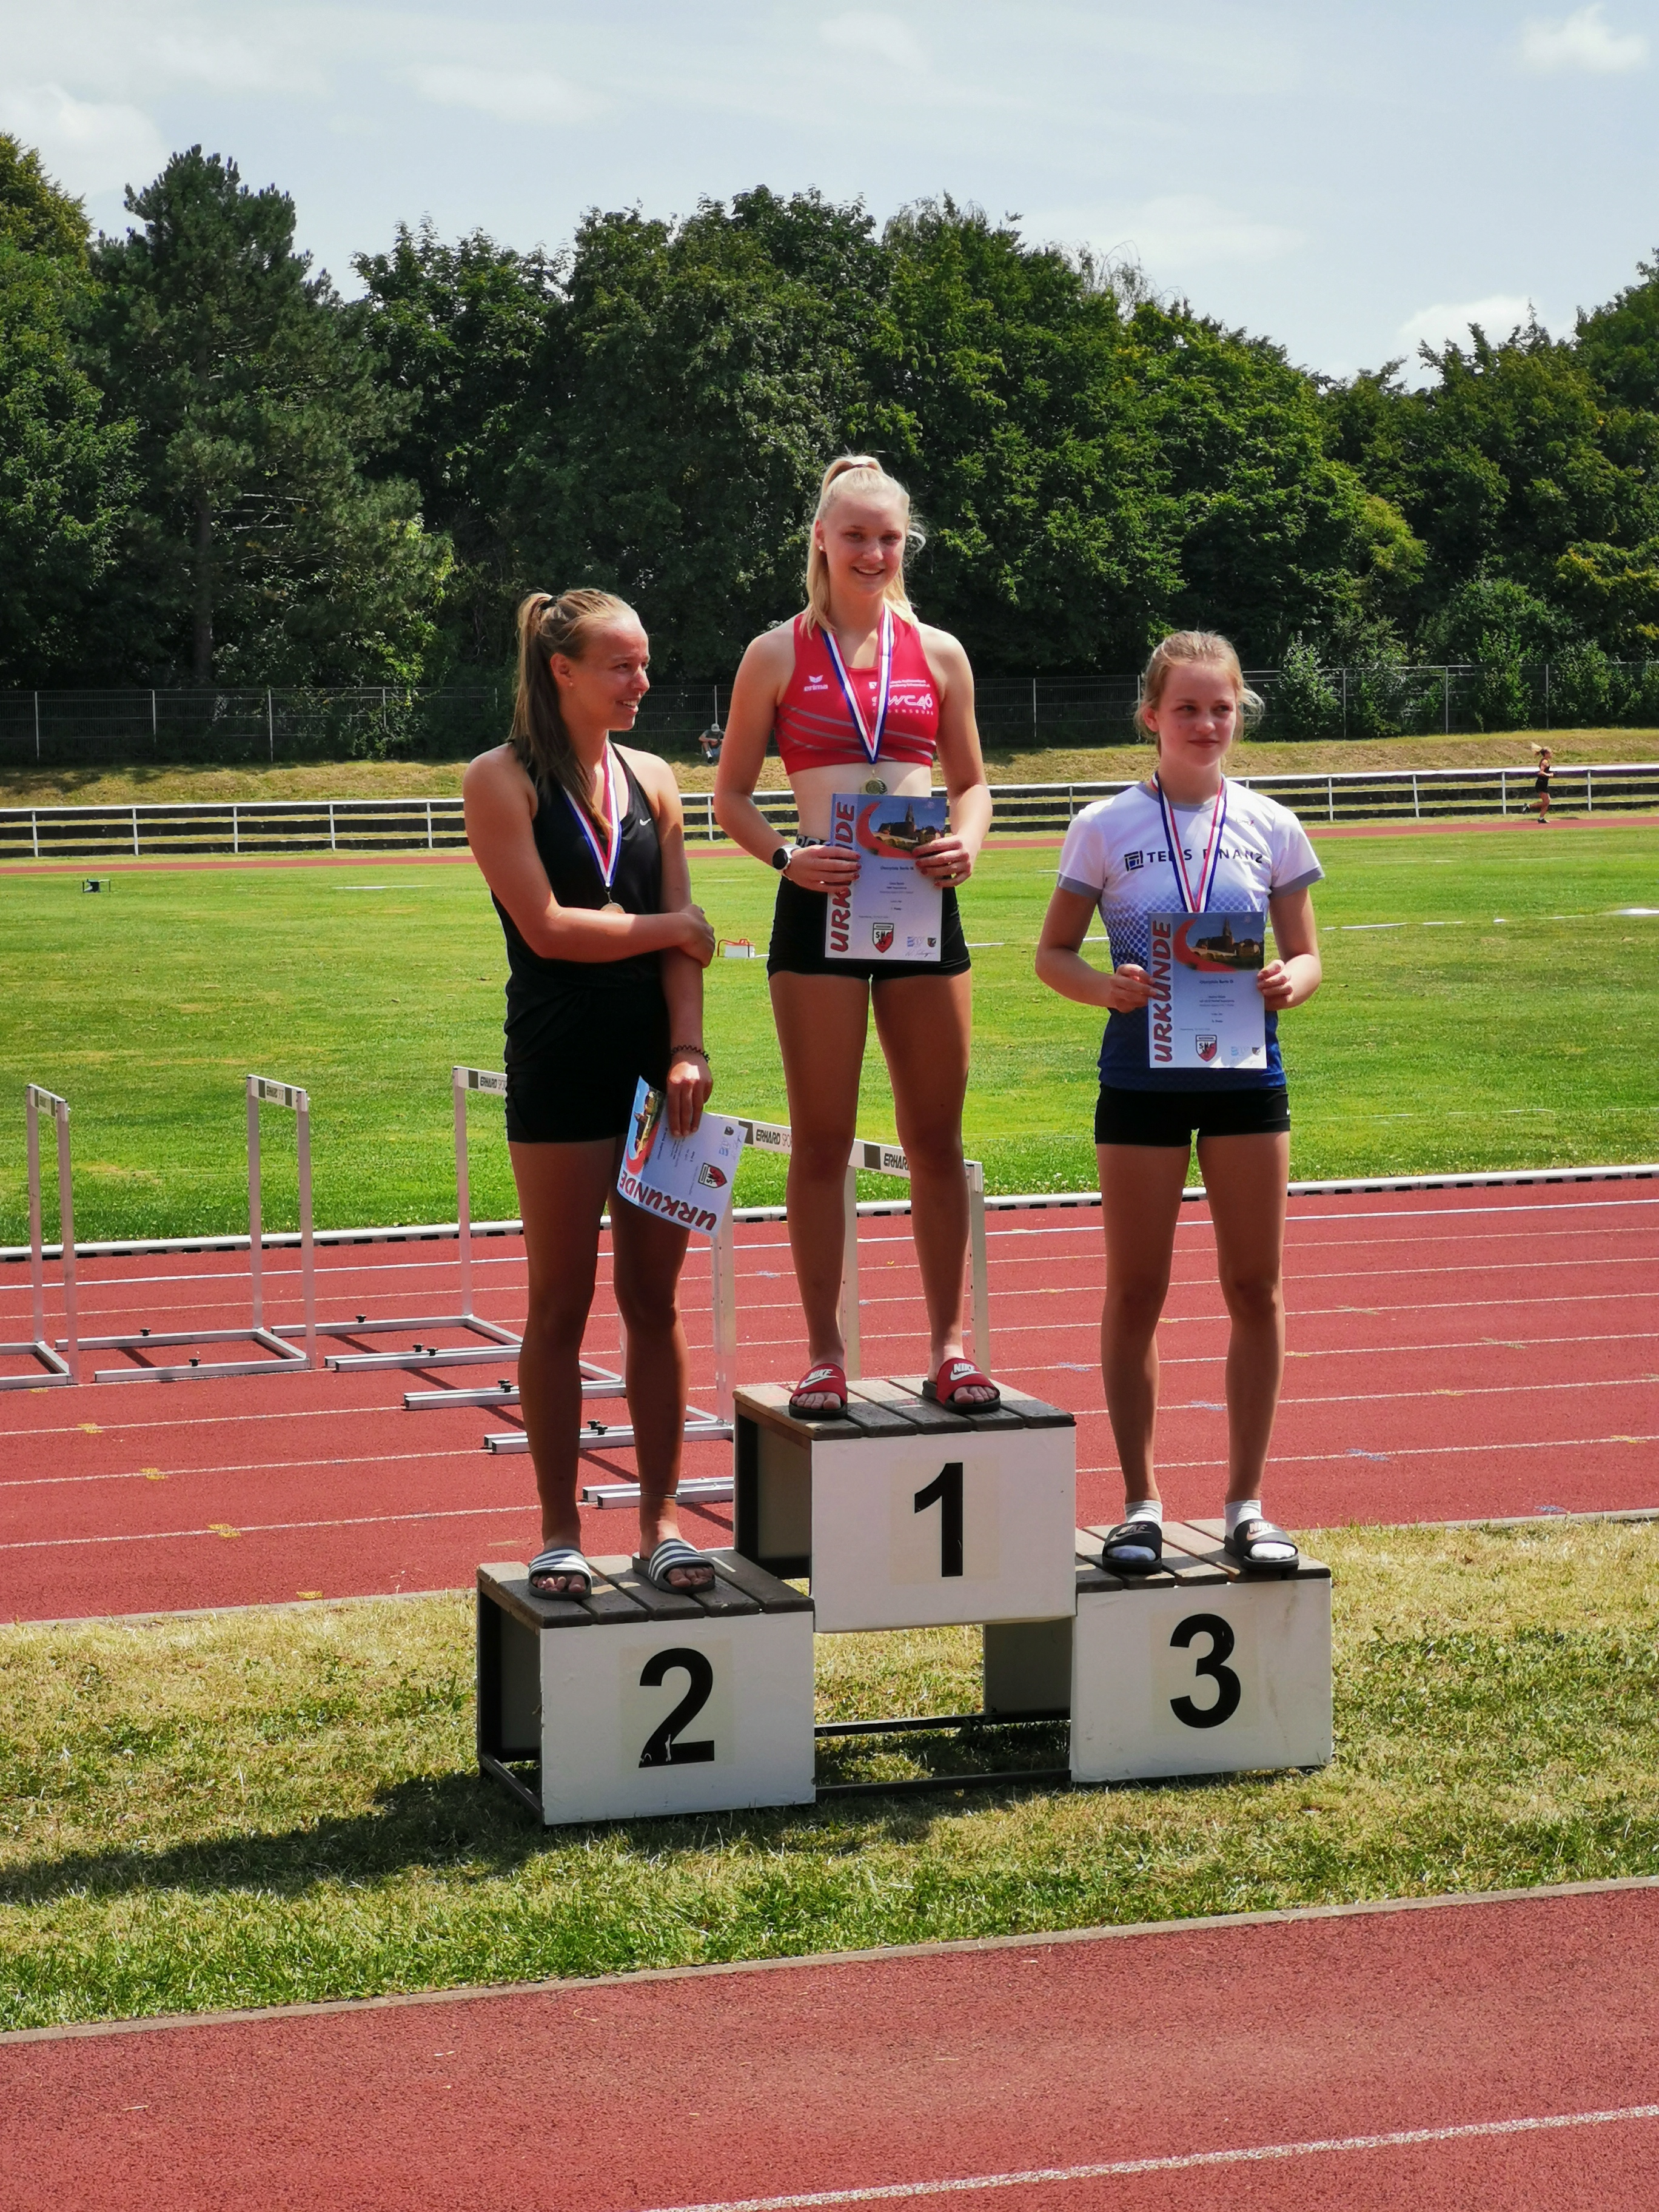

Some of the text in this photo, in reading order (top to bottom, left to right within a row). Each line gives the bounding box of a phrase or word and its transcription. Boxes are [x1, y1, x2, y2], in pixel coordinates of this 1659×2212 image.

[830, 801, 854, 953] URKDE
[1147, 848, 1263, 864] TES FNANZ
[1153, 920, 1173, 1062] URKUNDE
[756, 1128, 780, 1145] ERHARD
[883, 1153, 909, 1171] ERHAR
[619, 1169, 717, 1232] URKUNDE
[807, 1369, 833, 1381] NIKE
[954, 1362, 976, 1374] NIKE
[914, 1463, 963, 1577] 1
[1170, 1614, 1241, 1728] 3
[638, 1648, 714, 1768] 2
